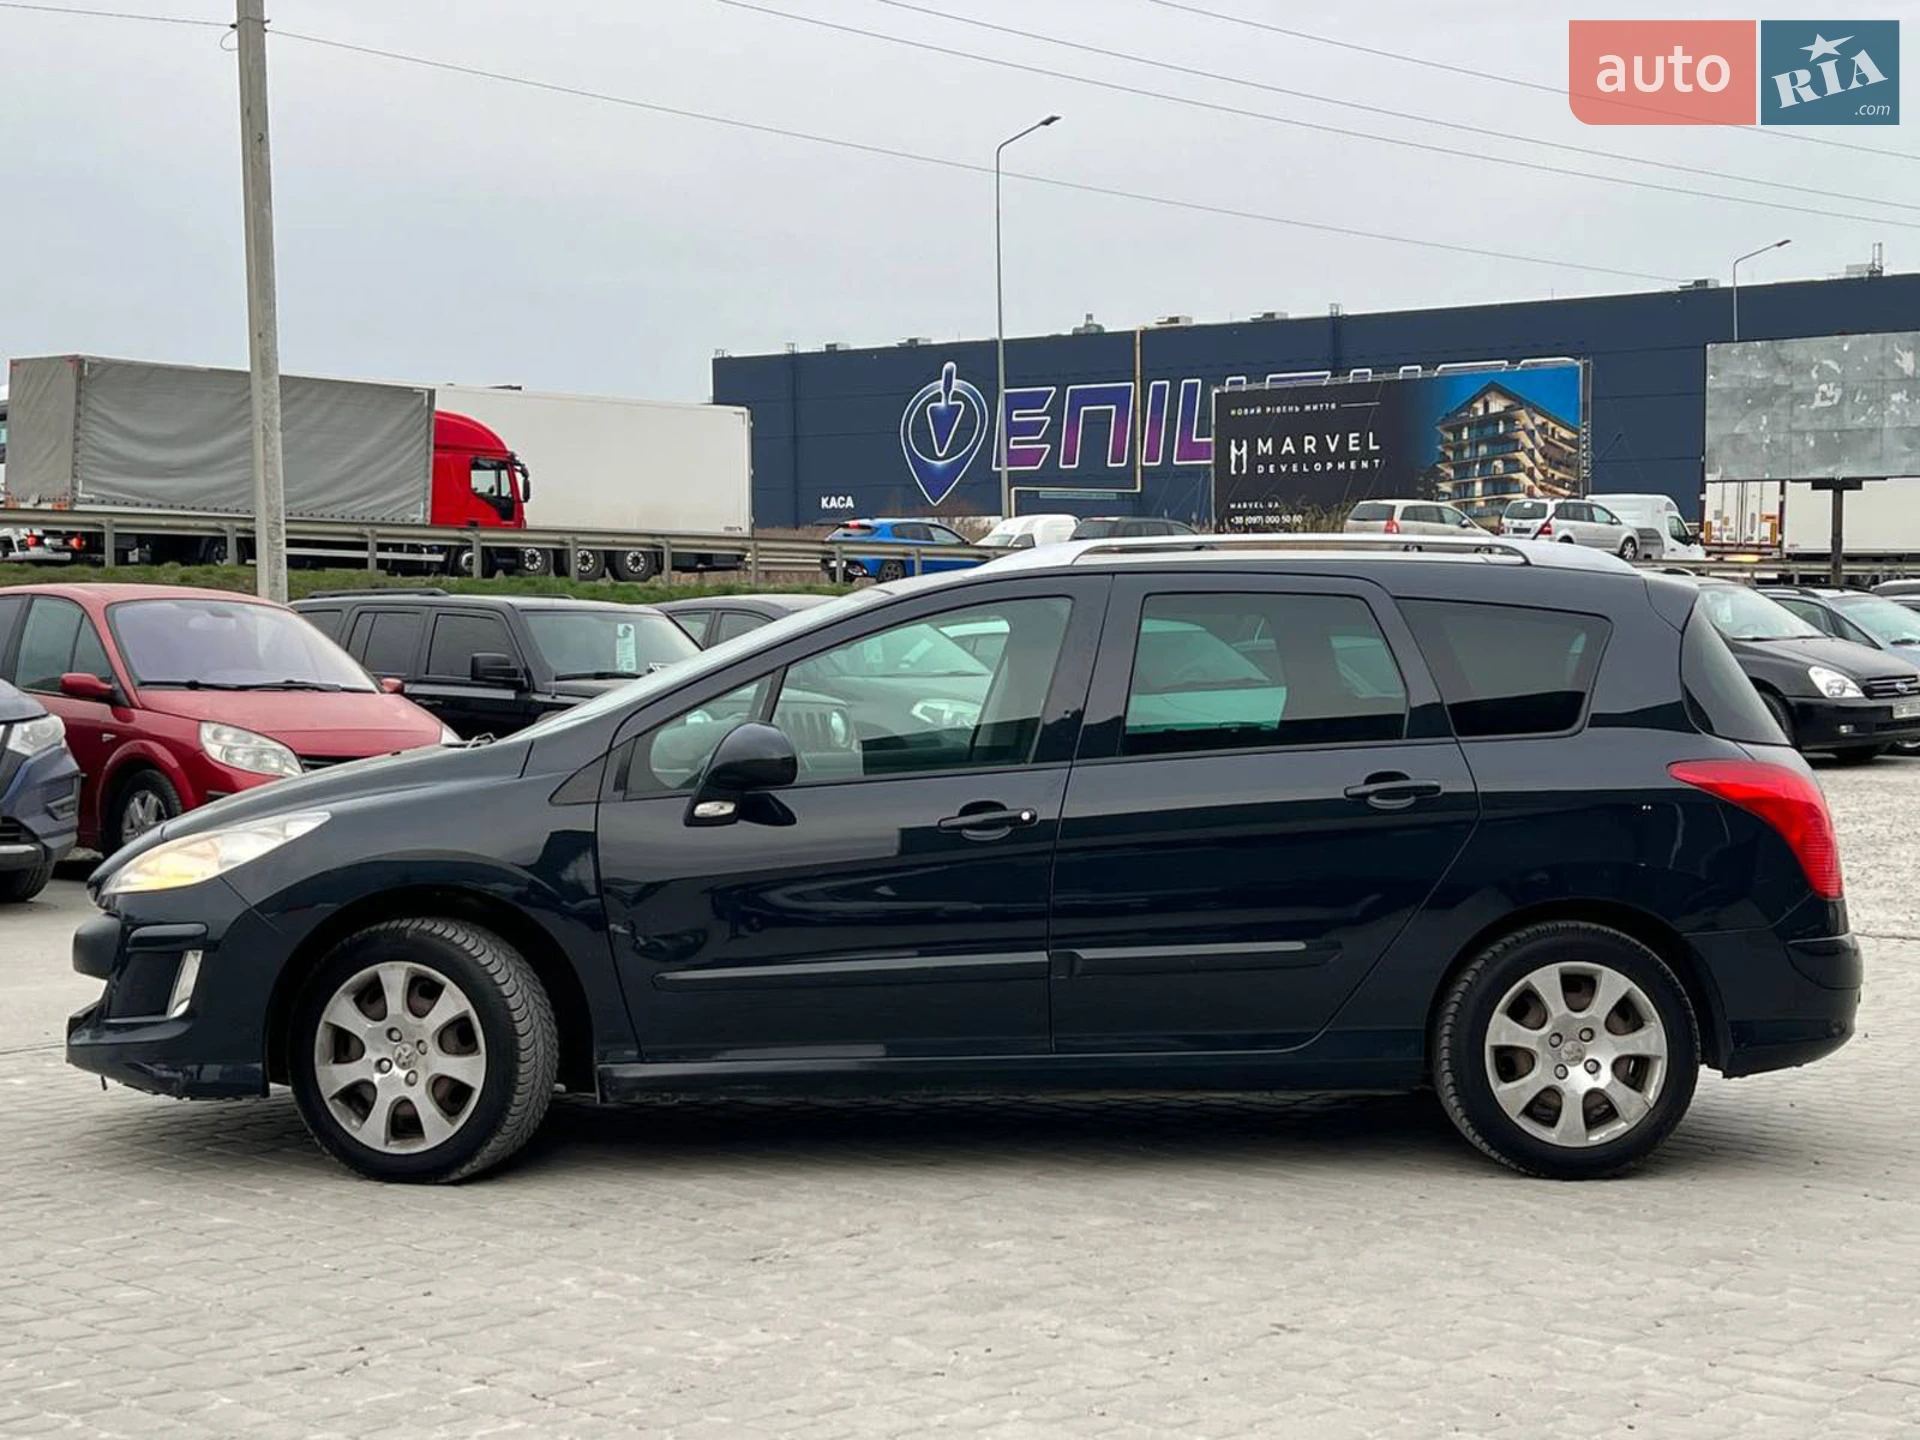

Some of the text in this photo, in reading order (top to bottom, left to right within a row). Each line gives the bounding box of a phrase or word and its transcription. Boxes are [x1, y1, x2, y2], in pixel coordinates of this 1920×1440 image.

[1257, 431, 1380, 456] MARVEL
[1257, 459, 1380, 474] DEVELOPMENT
[820, 495, 855, 510] КАСА
